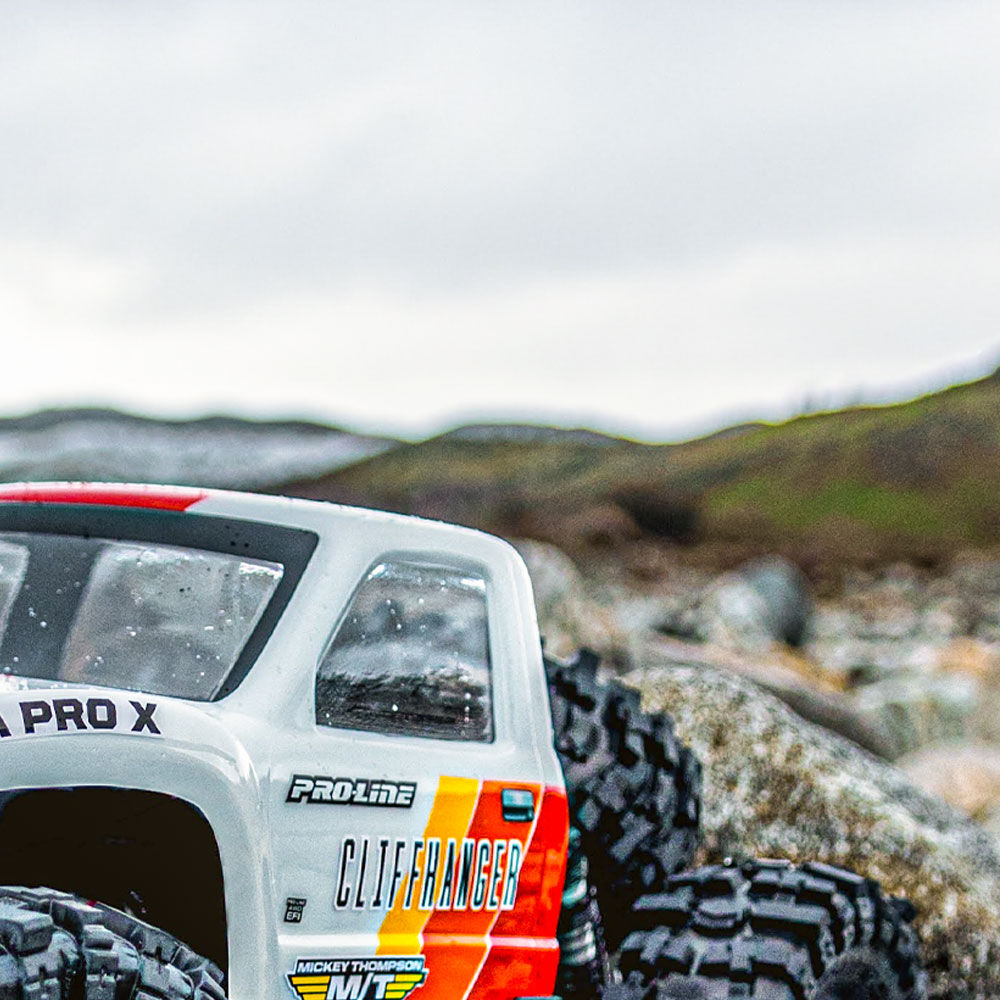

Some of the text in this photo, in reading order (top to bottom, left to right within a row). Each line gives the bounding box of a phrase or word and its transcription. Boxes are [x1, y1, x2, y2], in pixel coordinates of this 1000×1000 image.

[19, 699, 117, 734] PRO
[128, 700, 162, 735] X
[335, 838, 521, 908] CLIFFHANGER
[297, 960, 422, 973] MICKEY THOMPSON
